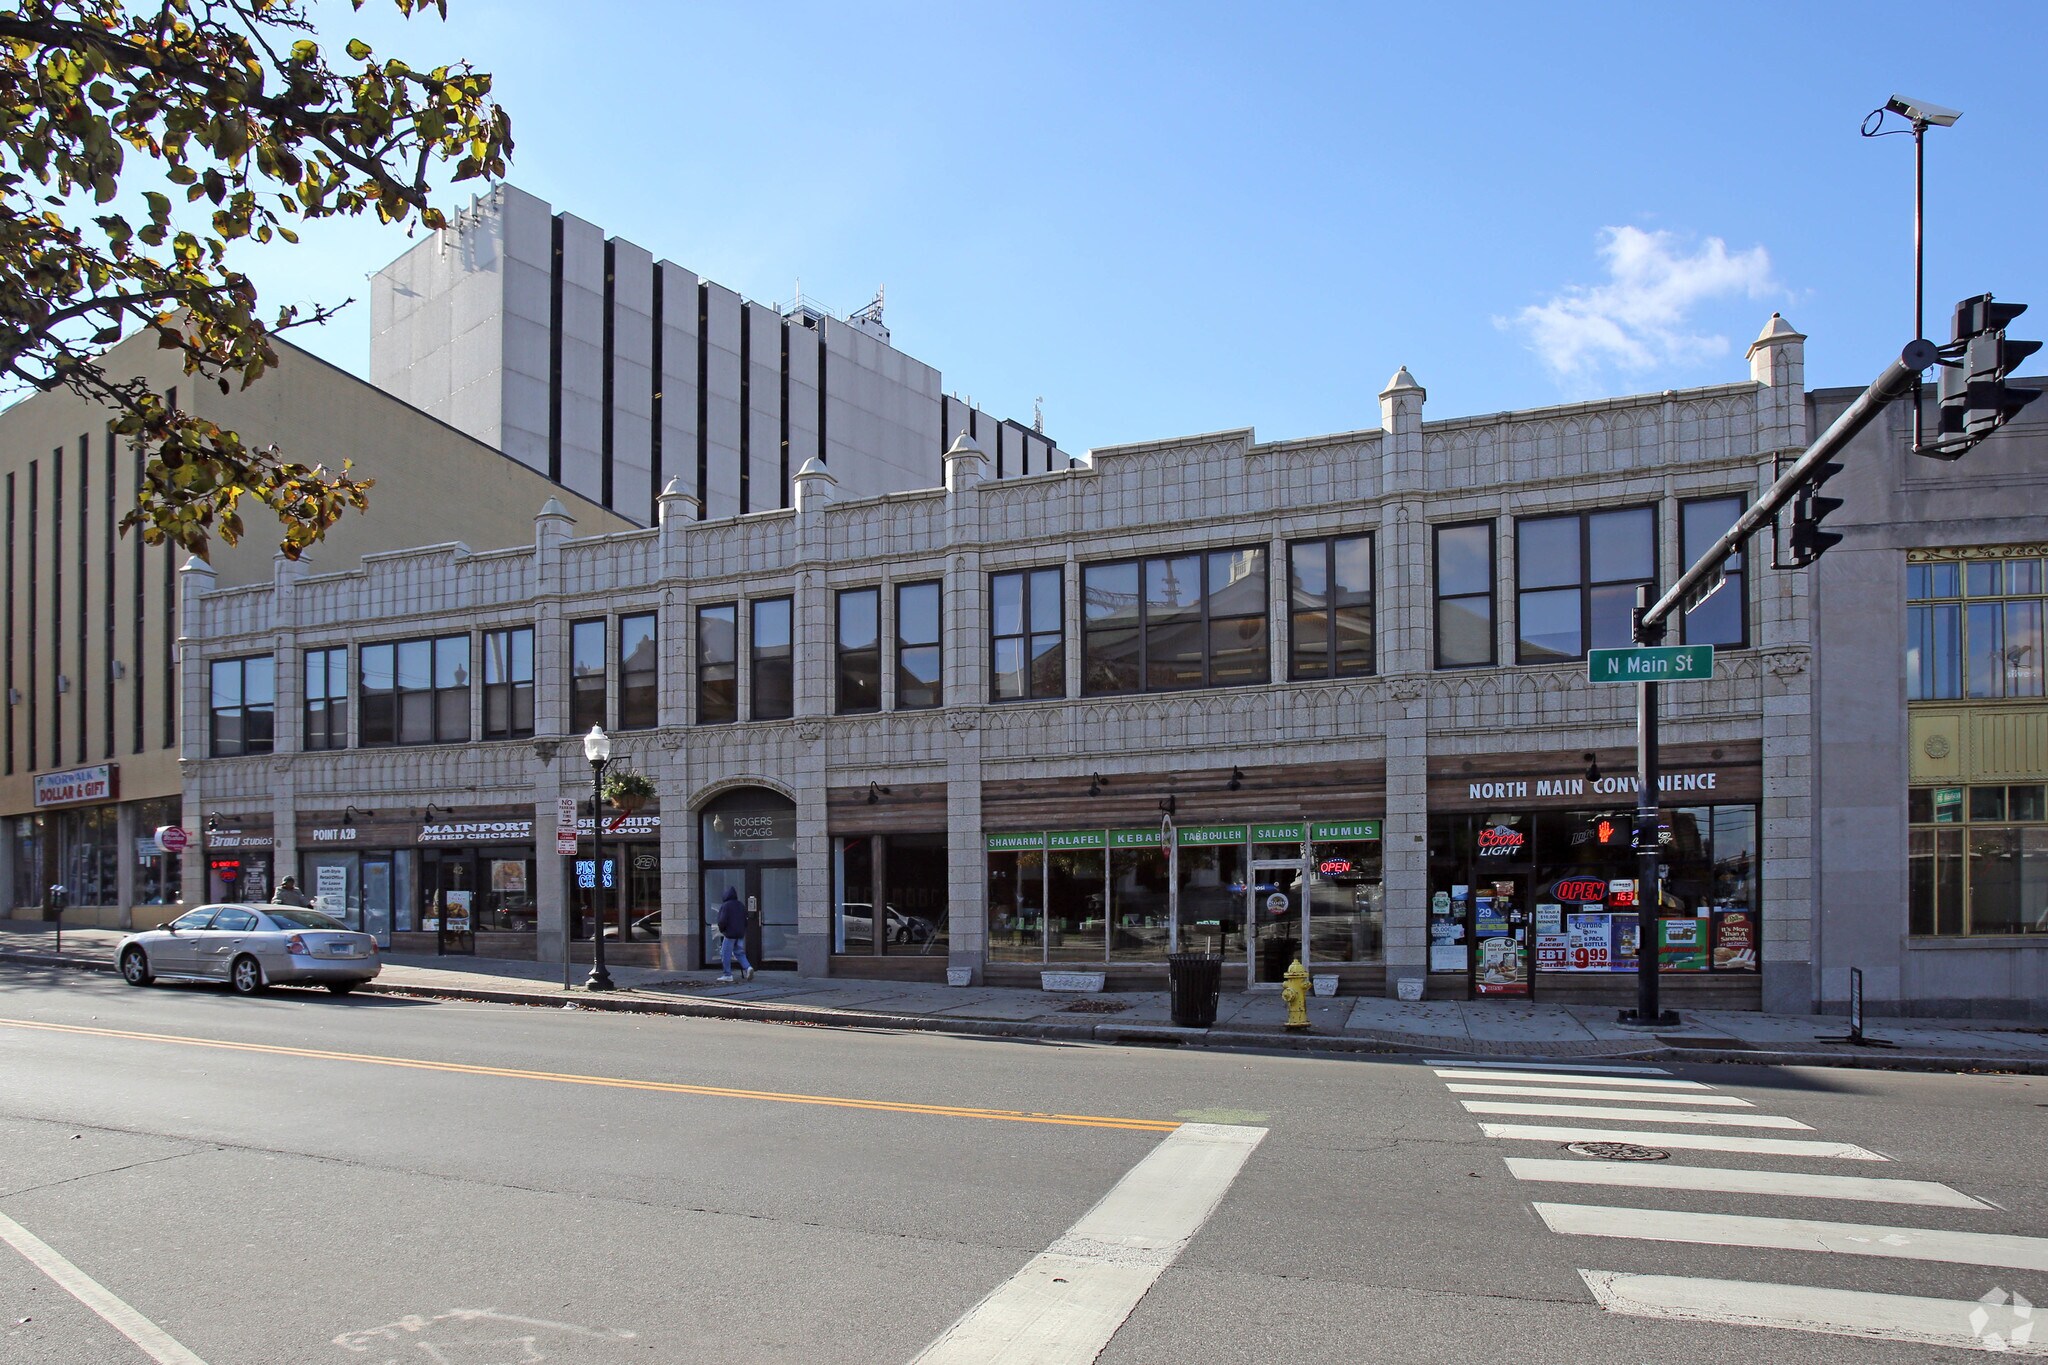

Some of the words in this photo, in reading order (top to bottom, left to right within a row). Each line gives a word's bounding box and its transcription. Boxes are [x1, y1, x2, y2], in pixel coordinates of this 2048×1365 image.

[1608, 658, 1619, 674] N
[1627, 656, 1667, 673] Main
[1675, 654, 1693, 672] St
[47, 770, 93, 786] NORWALK
[1469, 781, 1528, 799] NORTH
[1536, 778, 1583, 796] MAIN
[1593, 773, 1716, 794] CONVNIENCE
[40, 785, 74, 802] DOLLAR
[77, 784, 83, 798] &
[85, 781, 105, 797] GIFT
[601, 817, 612, 827] &
[733, 816, 773, 827] ROGERS
[423, 822, 533, 834] MAINPORT
[733, 827, 773, 837] McCAGG
[1258, 828, 1299, 838] SALADS
[1319, 826, 1373, 837] HUMUS
[313, 829, 338, 841] POINT
[339, 828, 356, 840] A2B
[424, 833, 465, 841] FRIED
[467, 831, 531, 840] CHICKEN
[1117, 833, 1161, 843] KEBAB
[1183, 831, 1241, 841] TABBOULEH
[1478, 829, 1525, 847] Coors
[989, 838, 1043, 847] SHAWARMA
[1051, 835, 1101, 845] FALAFEL
[1479, 845, 1522, 857] LIGHT
[576, 860, 596, 875] FIS
[633, 857, 658, 868] OPEN
[1320, 862, 1350, 872] OPEN
[453, 866, 464, 875] 42
[1557, 881, 1605, 900] OPEN
[1617, 892, 1634, 901] 163
[1574, 921, 1603, 930] Corona
[1538, 950, 1565, 960] EBT
